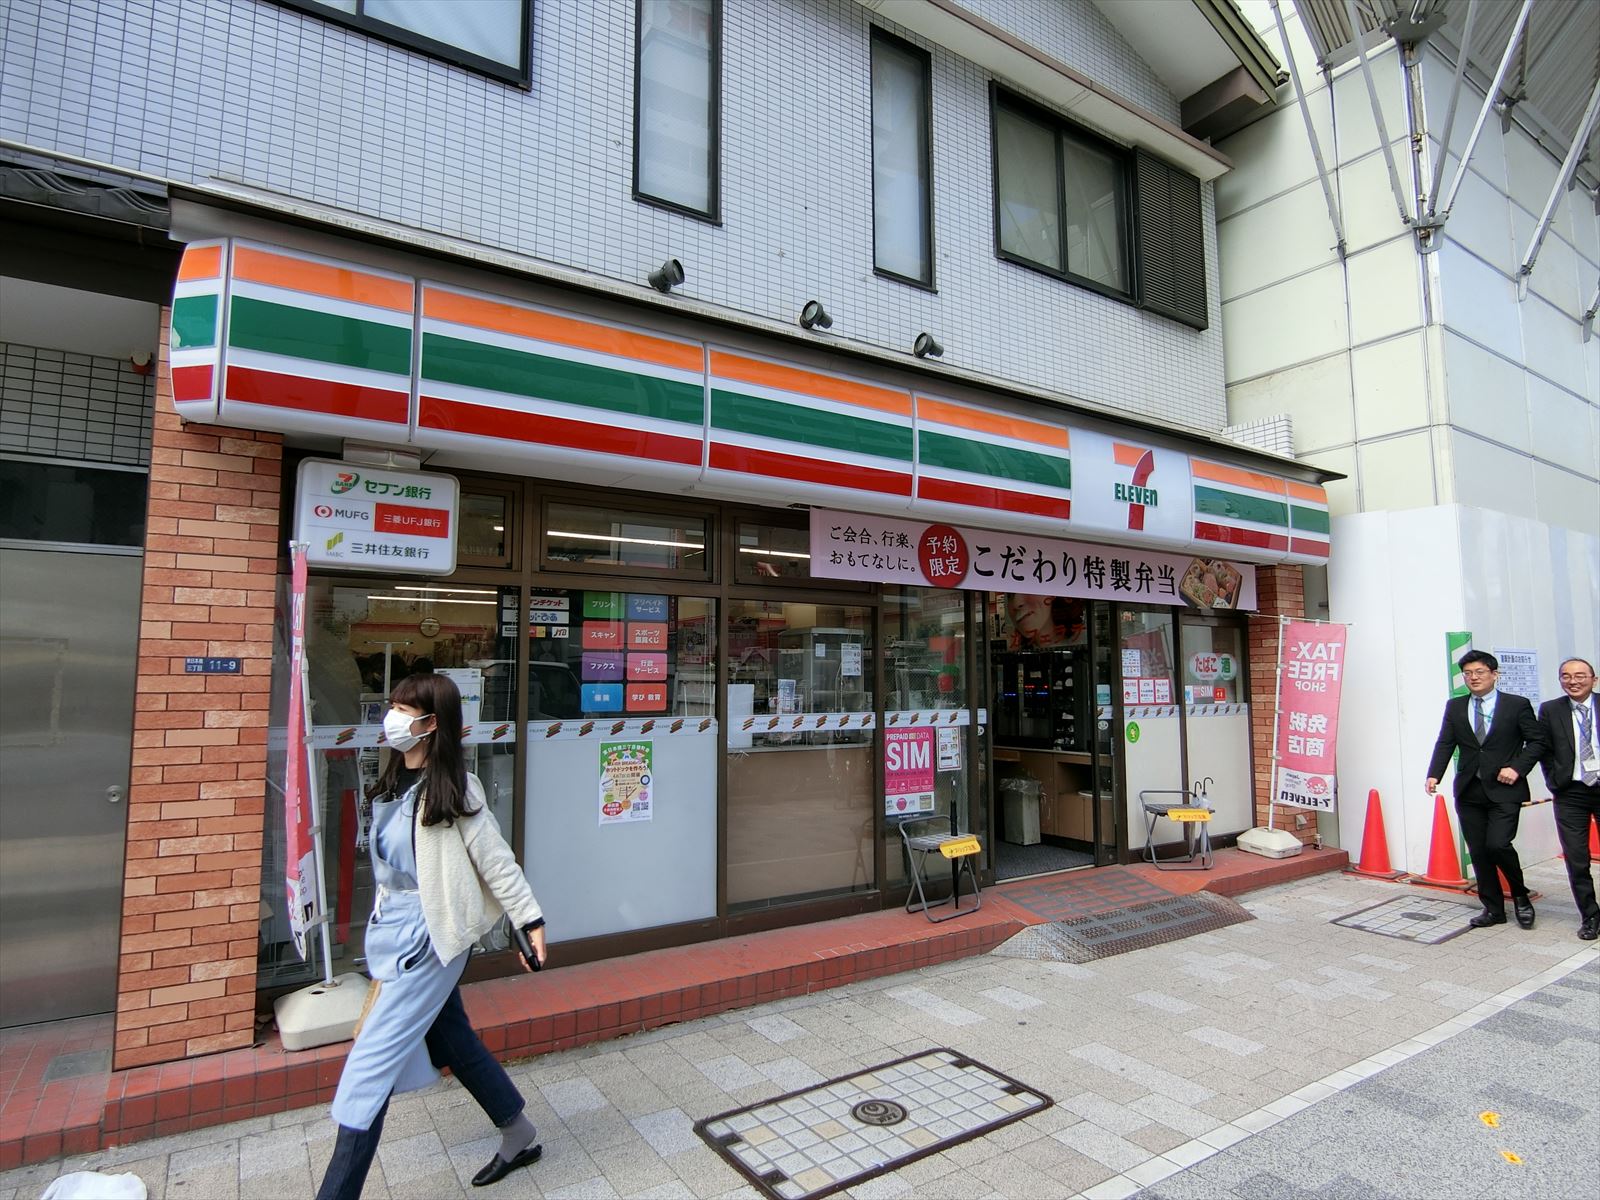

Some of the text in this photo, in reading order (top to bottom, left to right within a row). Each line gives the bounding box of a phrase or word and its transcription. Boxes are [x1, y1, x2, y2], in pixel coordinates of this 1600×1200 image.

[364, 479, 432, 500] セブン銀行
[335, 510, 369, 521] MUFG
[383, 514, 441, 529] 三菱UFJ銀行
[830, 526, 915, 549] ご会合、行楽、
[926, 535, 958, 554] 予約
[351, 542, 430, 559] 三井住友銀行
[829, 550, 916, 573] おもてなしに。
[928, 557, 962, 577] 限定
[973, 544, 1176, 596] こだわり特製弁当
[592, 600, 616, 609] プリント
[636, 606, 661, 614] サービス
[591, 630, 616, 639] スキャン
[635, 629, 660, 637] スポーツ
[209, 661, 236, 670] 11-9
[590, 662, 616, 670] ファクス
[634, 666, 660, 674] サービス
[1195, 656, 1218, 673] たばこ
[1220, 658, 1231, 674] 酒
[886, 732, 909, 741] PREPAID
[886, 741, 930, 771] SIM
